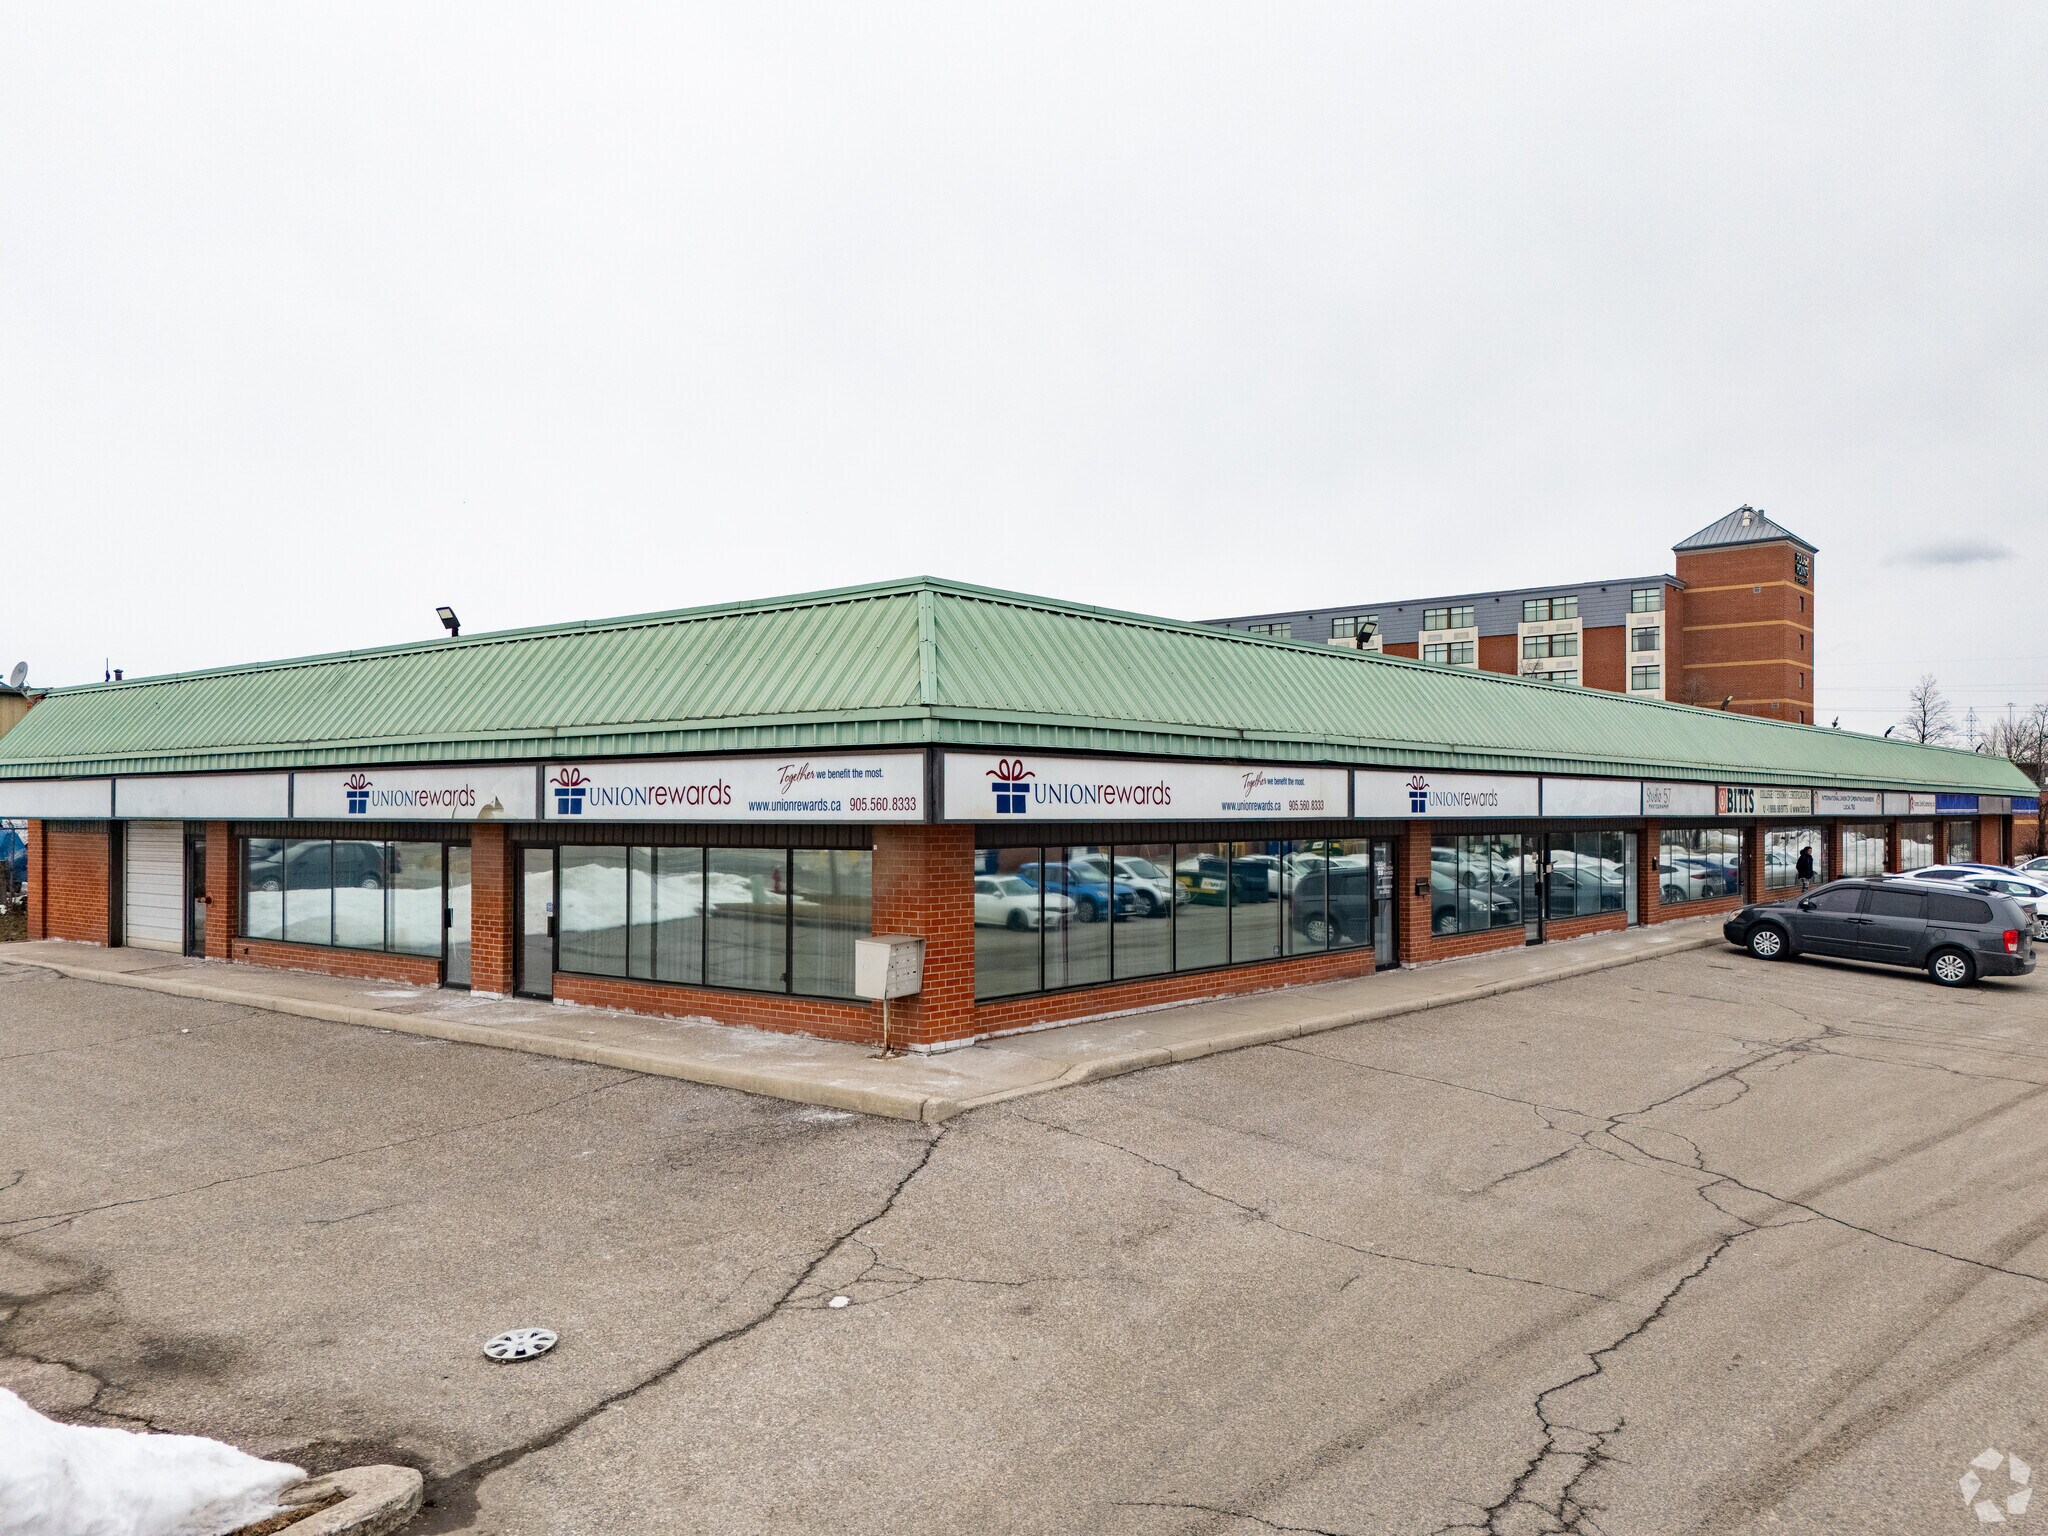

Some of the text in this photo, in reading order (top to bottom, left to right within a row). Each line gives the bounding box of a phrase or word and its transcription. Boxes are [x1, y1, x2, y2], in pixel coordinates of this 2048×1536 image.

[777, 762, 884, 795] Together we benefit the most.
[1242, 771, 1266, 797] Together
[1267, 778, 1274, 786] we
[1274, 776, 1287, 786] benefit
[589, 778, 731, 806] UNIONrewards
[1034, 780, 1171, 805] UNIONrewards
[1663, 787, 1672, 804] 57
[1727, 788, 1755, 814] BITTS
[748, 798, 841, 812] www.unionrewards.ca
[849, 797, 917, 812] 905.560.8333
[1221, 800, 1281, 811] www.unionrewards.ca
[1288, 800, 1324, 811] 905.560.8333
